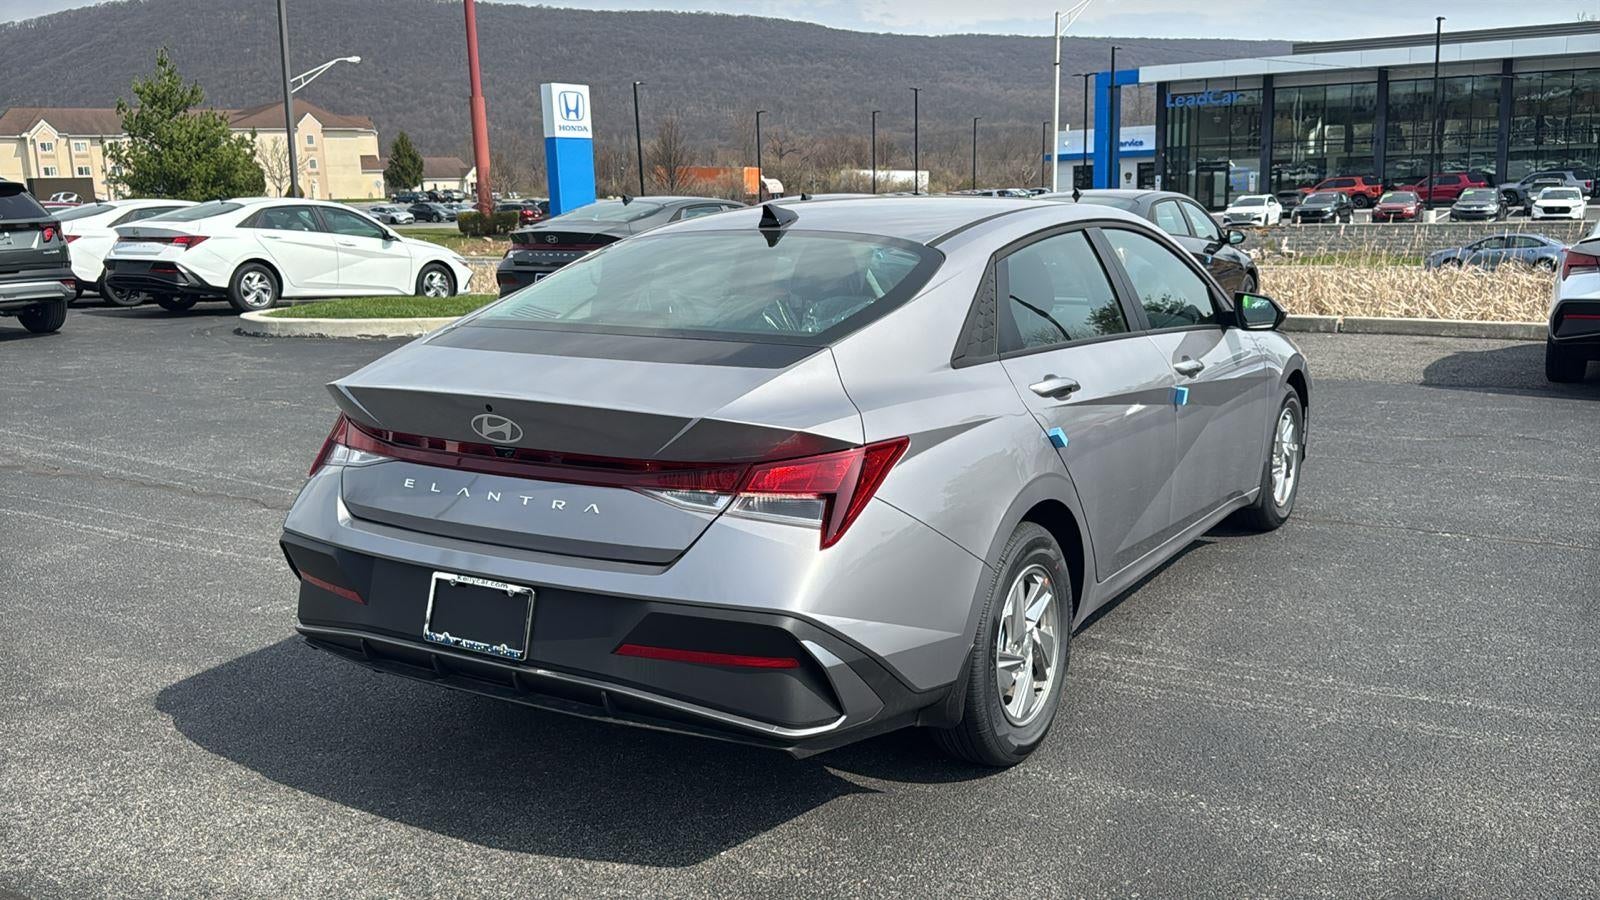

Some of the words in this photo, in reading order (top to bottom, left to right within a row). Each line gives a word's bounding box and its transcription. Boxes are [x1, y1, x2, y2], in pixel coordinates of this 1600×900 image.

[1166, 88, 1240, 108] LeadCar
[558, 124, 589, 132] HONDA
[404, 478, 600, 514] ELANTRA
